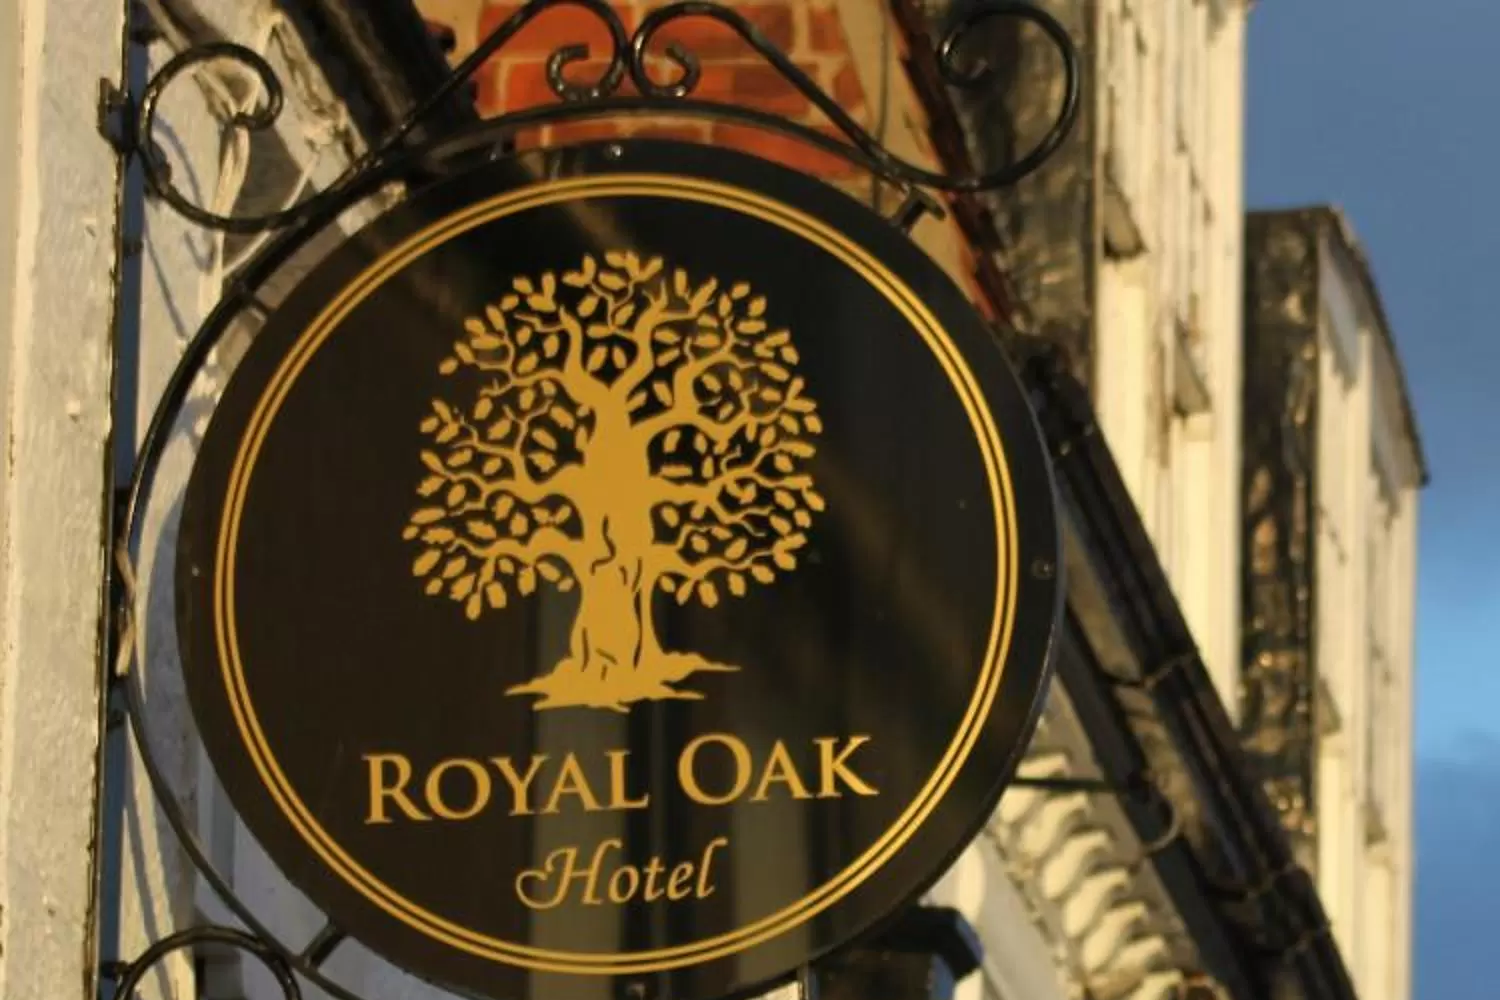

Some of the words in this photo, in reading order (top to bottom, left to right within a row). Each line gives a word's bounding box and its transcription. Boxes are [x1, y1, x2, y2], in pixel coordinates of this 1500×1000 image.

[362, 750, 649, 824] ROYAL
[677, 733, 879, 804] OAK
[515, 837, 728, 909] Hotel
